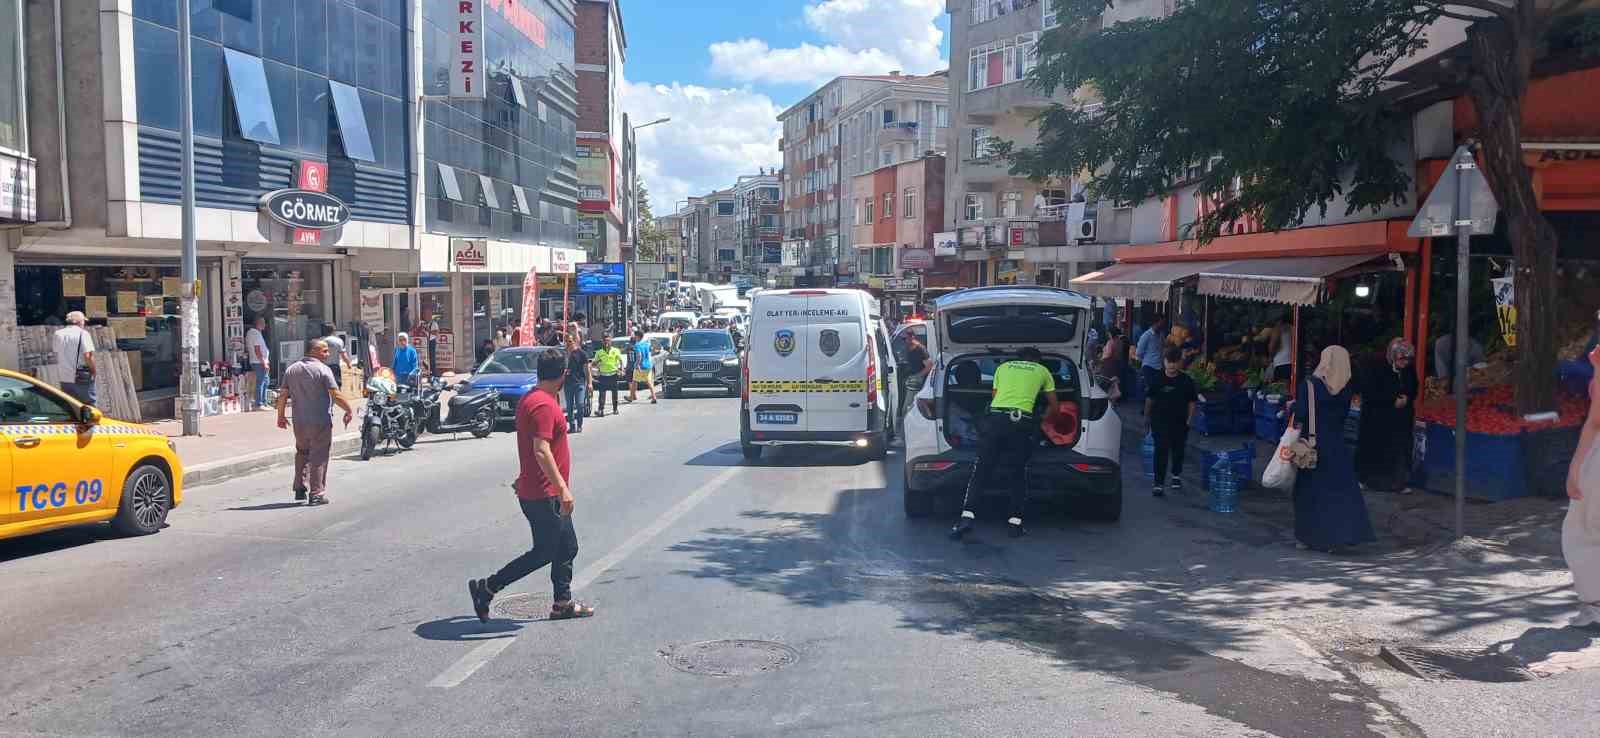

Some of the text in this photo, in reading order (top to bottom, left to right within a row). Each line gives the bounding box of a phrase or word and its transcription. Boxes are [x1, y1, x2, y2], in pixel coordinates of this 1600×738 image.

[281, 197, 340, 222] GÖRMEZ
[456, 249, 485, 258] ACİL
[16, 479, 102, 511] TCG 09
